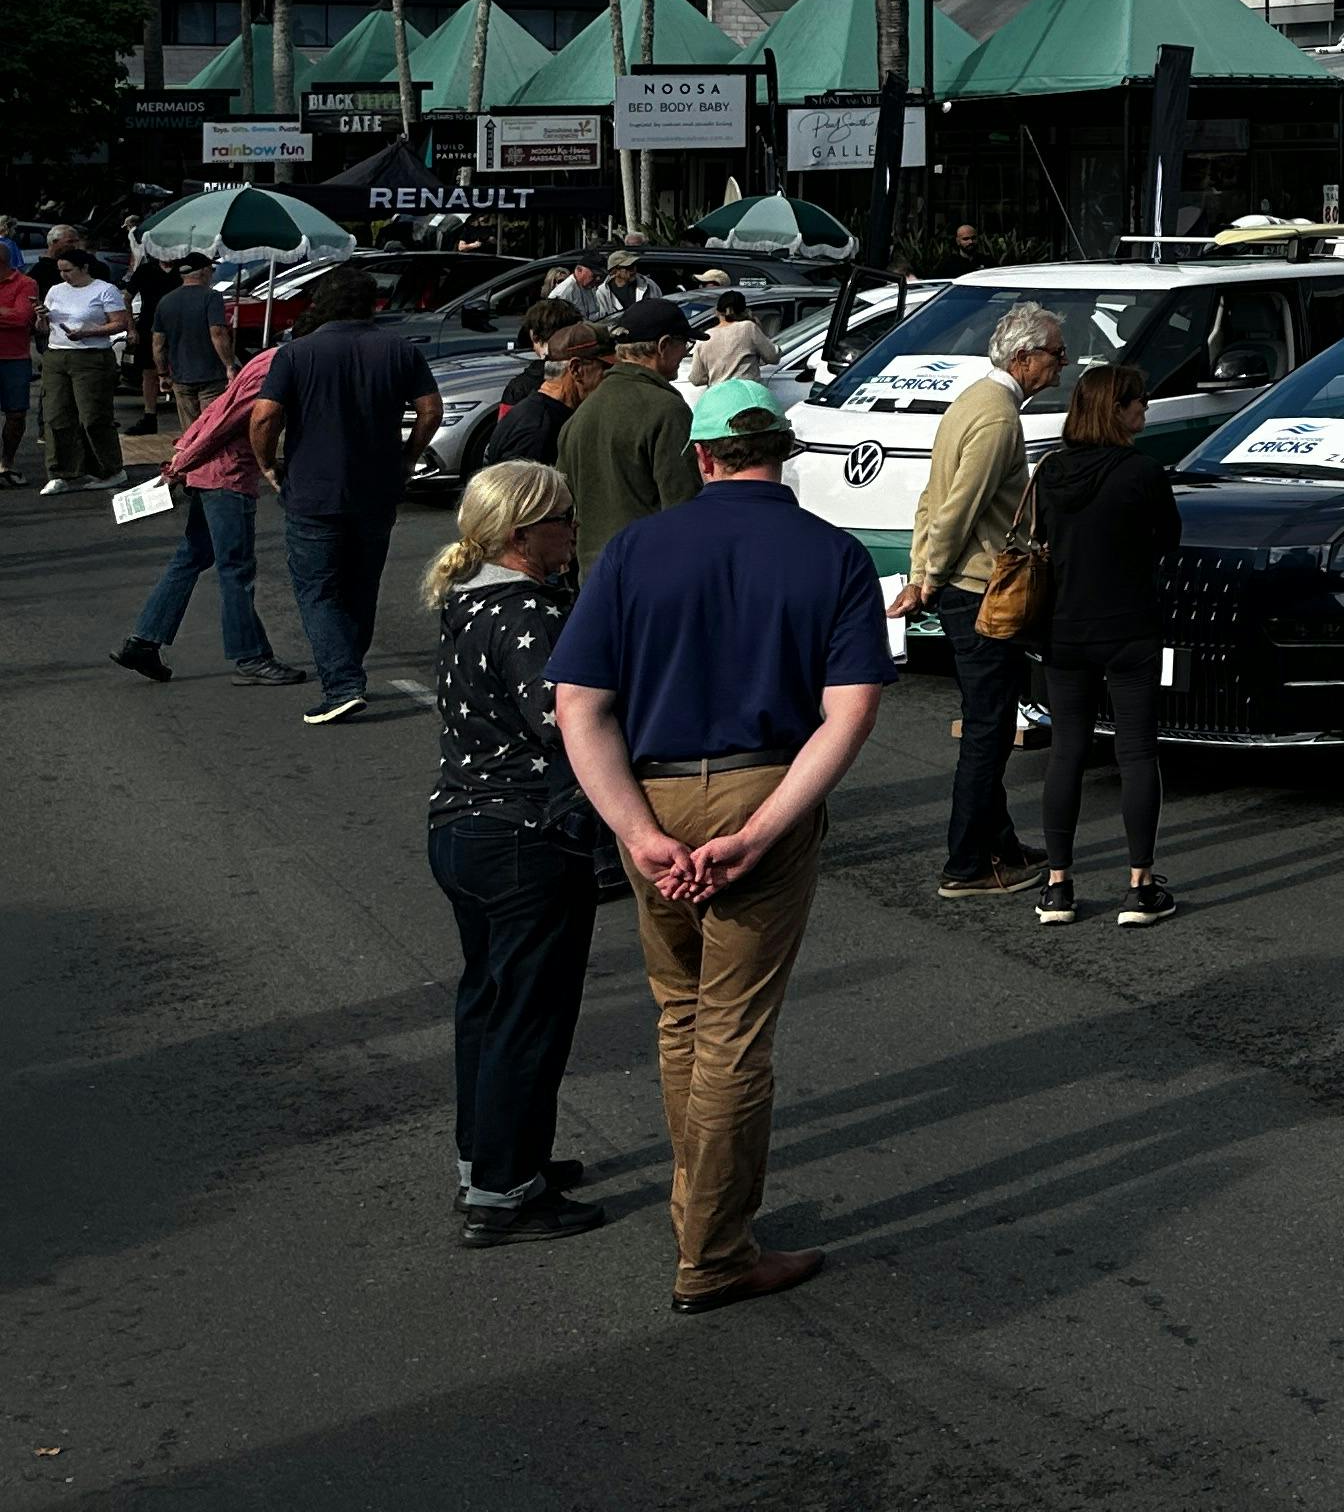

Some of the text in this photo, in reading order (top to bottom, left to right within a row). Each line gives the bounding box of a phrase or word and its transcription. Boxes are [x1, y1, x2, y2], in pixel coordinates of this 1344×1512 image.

[644, 83, 721, 95] NOOSA
[136, 101, 206, 113] MERMAIDS
[308, 93, 401, 110] BLACK PEPPE
[628, 102, 653, 113] BED
[339, 115, 383, 133] CAFE
[212, 142, 305, 157] rainbow fun
[812, 144, 877, 159] GALLE
[368, 187, 535, 209] RENAULT
[891, 378, 954, 391] CRICKS
[1247, 441, 1319, 454] CRICKS
